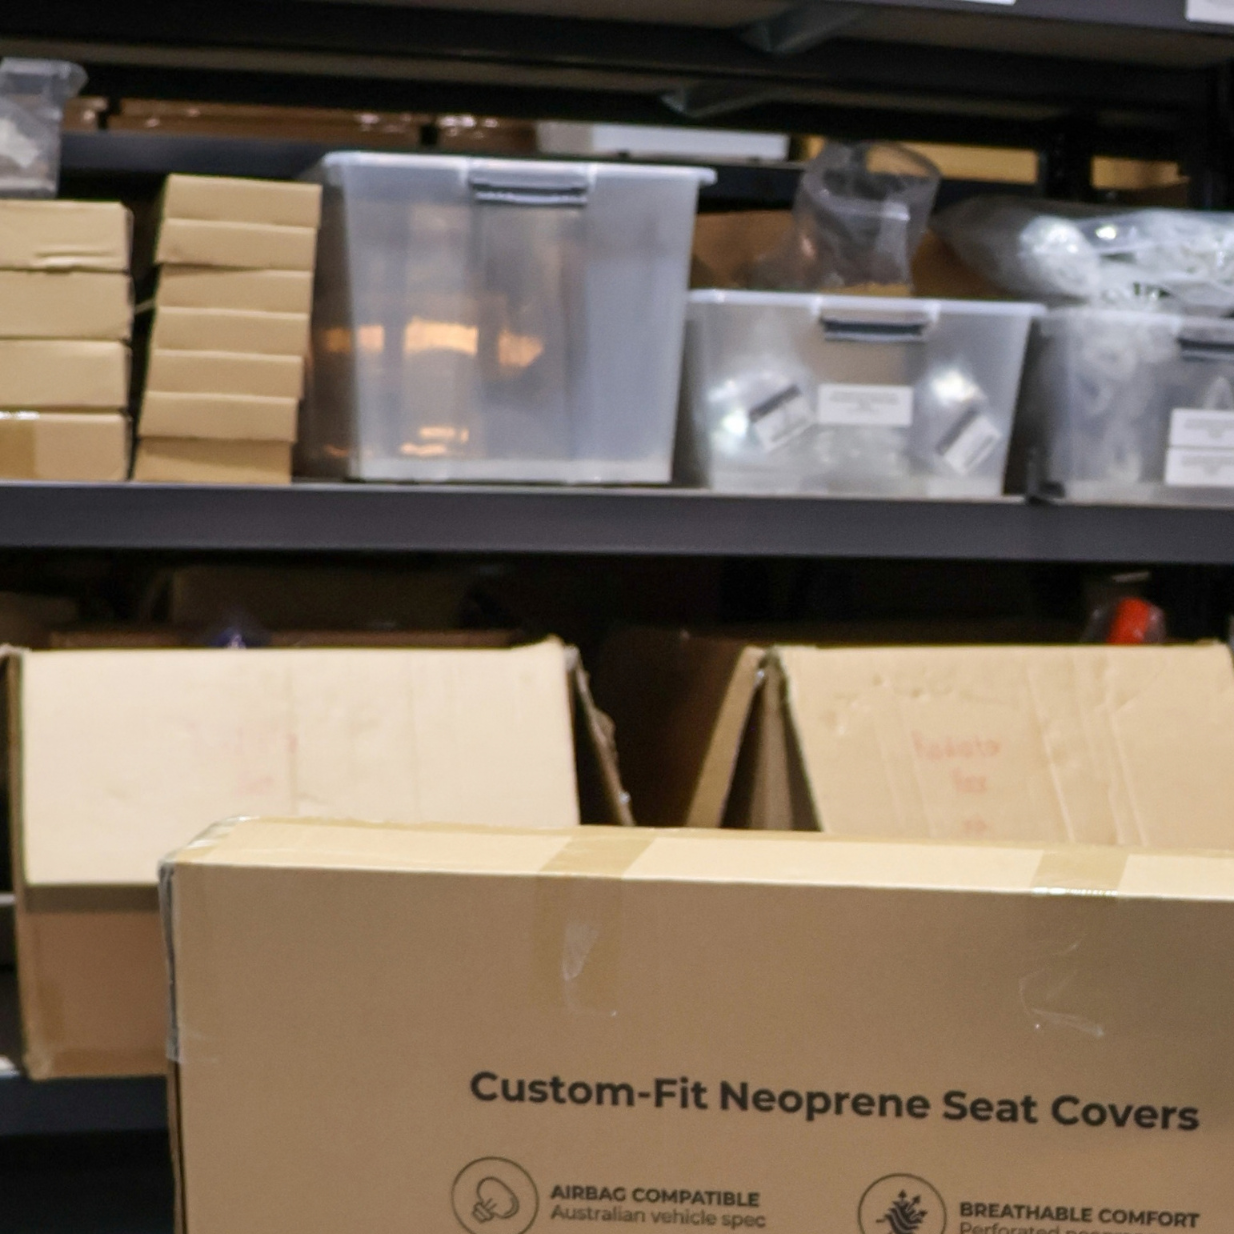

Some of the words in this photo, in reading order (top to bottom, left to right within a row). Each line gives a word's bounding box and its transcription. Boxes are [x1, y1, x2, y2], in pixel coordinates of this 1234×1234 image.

[469, 1070, 709, 1111] Custom-Fit
[719, 1080, 931, 1123] Neoprene
[942, 1089, 1039, 1125] Seat
[1050, 1094, 1200, 1132] Covers
[550, 1184, 627, 1202] AIRBAG
[631, 1186, 761, 1207] COMPATIBLE
[550, 1204, 645, 1223] Australian
[651, 1207, 717, 1227] vehicle
[722, 1212, 766, 1229] spec
[958, 1201, 1093, 1222] BREATHABLE
[1097, 1207, 1201, 1229] COMFORT
